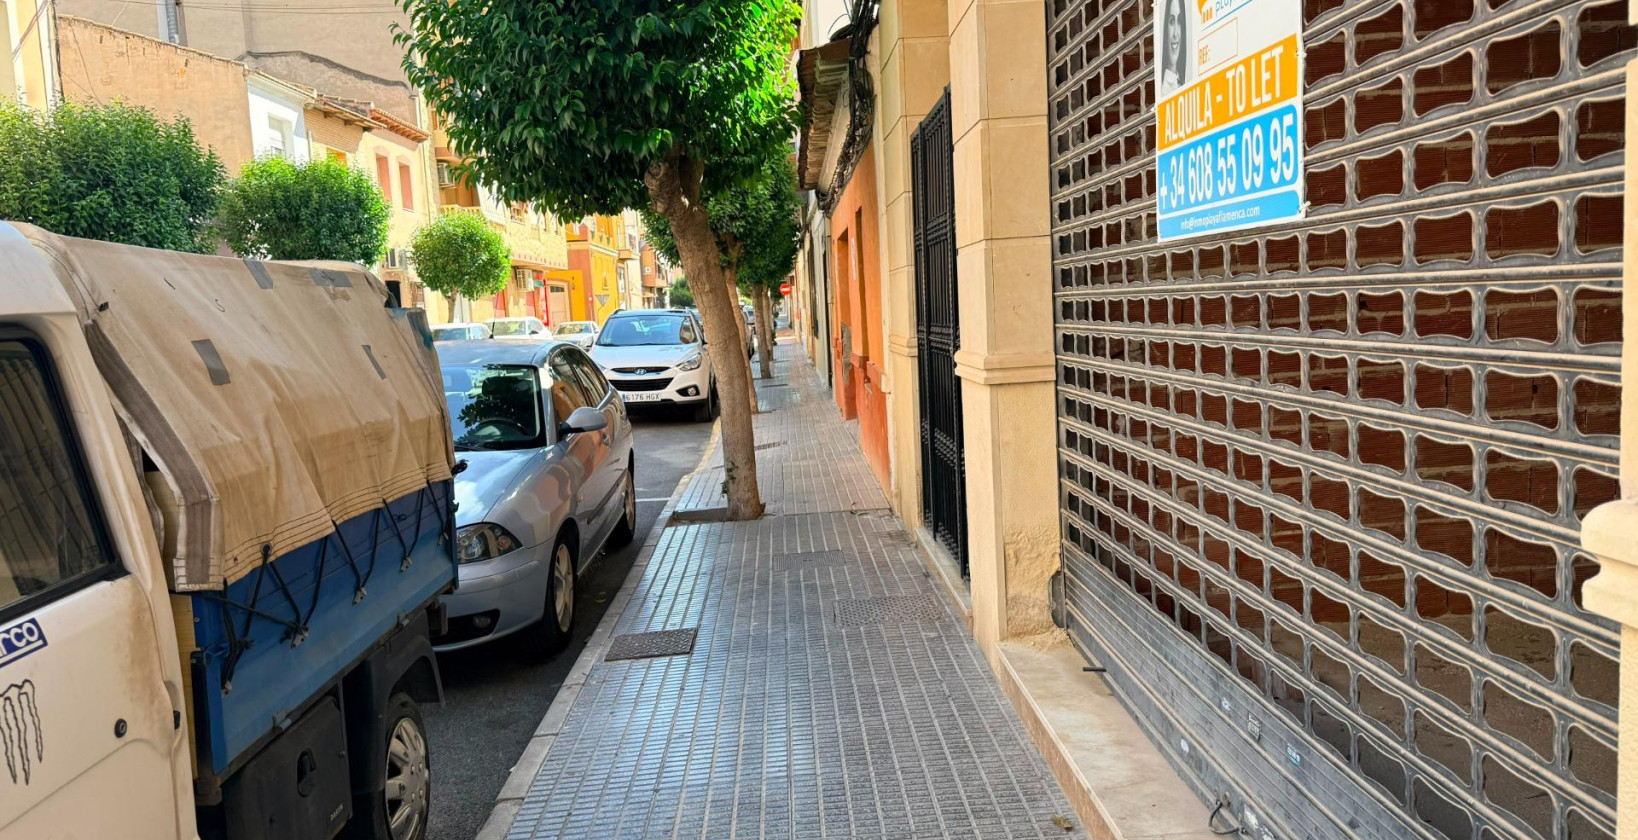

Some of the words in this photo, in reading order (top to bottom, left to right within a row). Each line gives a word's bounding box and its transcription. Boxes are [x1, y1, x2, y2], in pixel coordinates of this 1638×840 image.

[1198, 44, 1210, 66] REF:
[1165, 81, 1213, 144] ALQUILA
[1216, 93, 1222, 103] -
[1226, 64, 1246, 116] TO
[1251, 45, 1283, 107] LET
[1160, 172, 1168, 210] +
[1170, 152, 1185, 209] 34
[1188, 142, 1213, 204] 608
[1217, 133, 1236, 196] 55
[1241, 123, 1264, 191] 09
[1269, 112, 1294, 184] 95
[626, 393, 644, 401] 6176
[0, 622, 39, 656] rco
